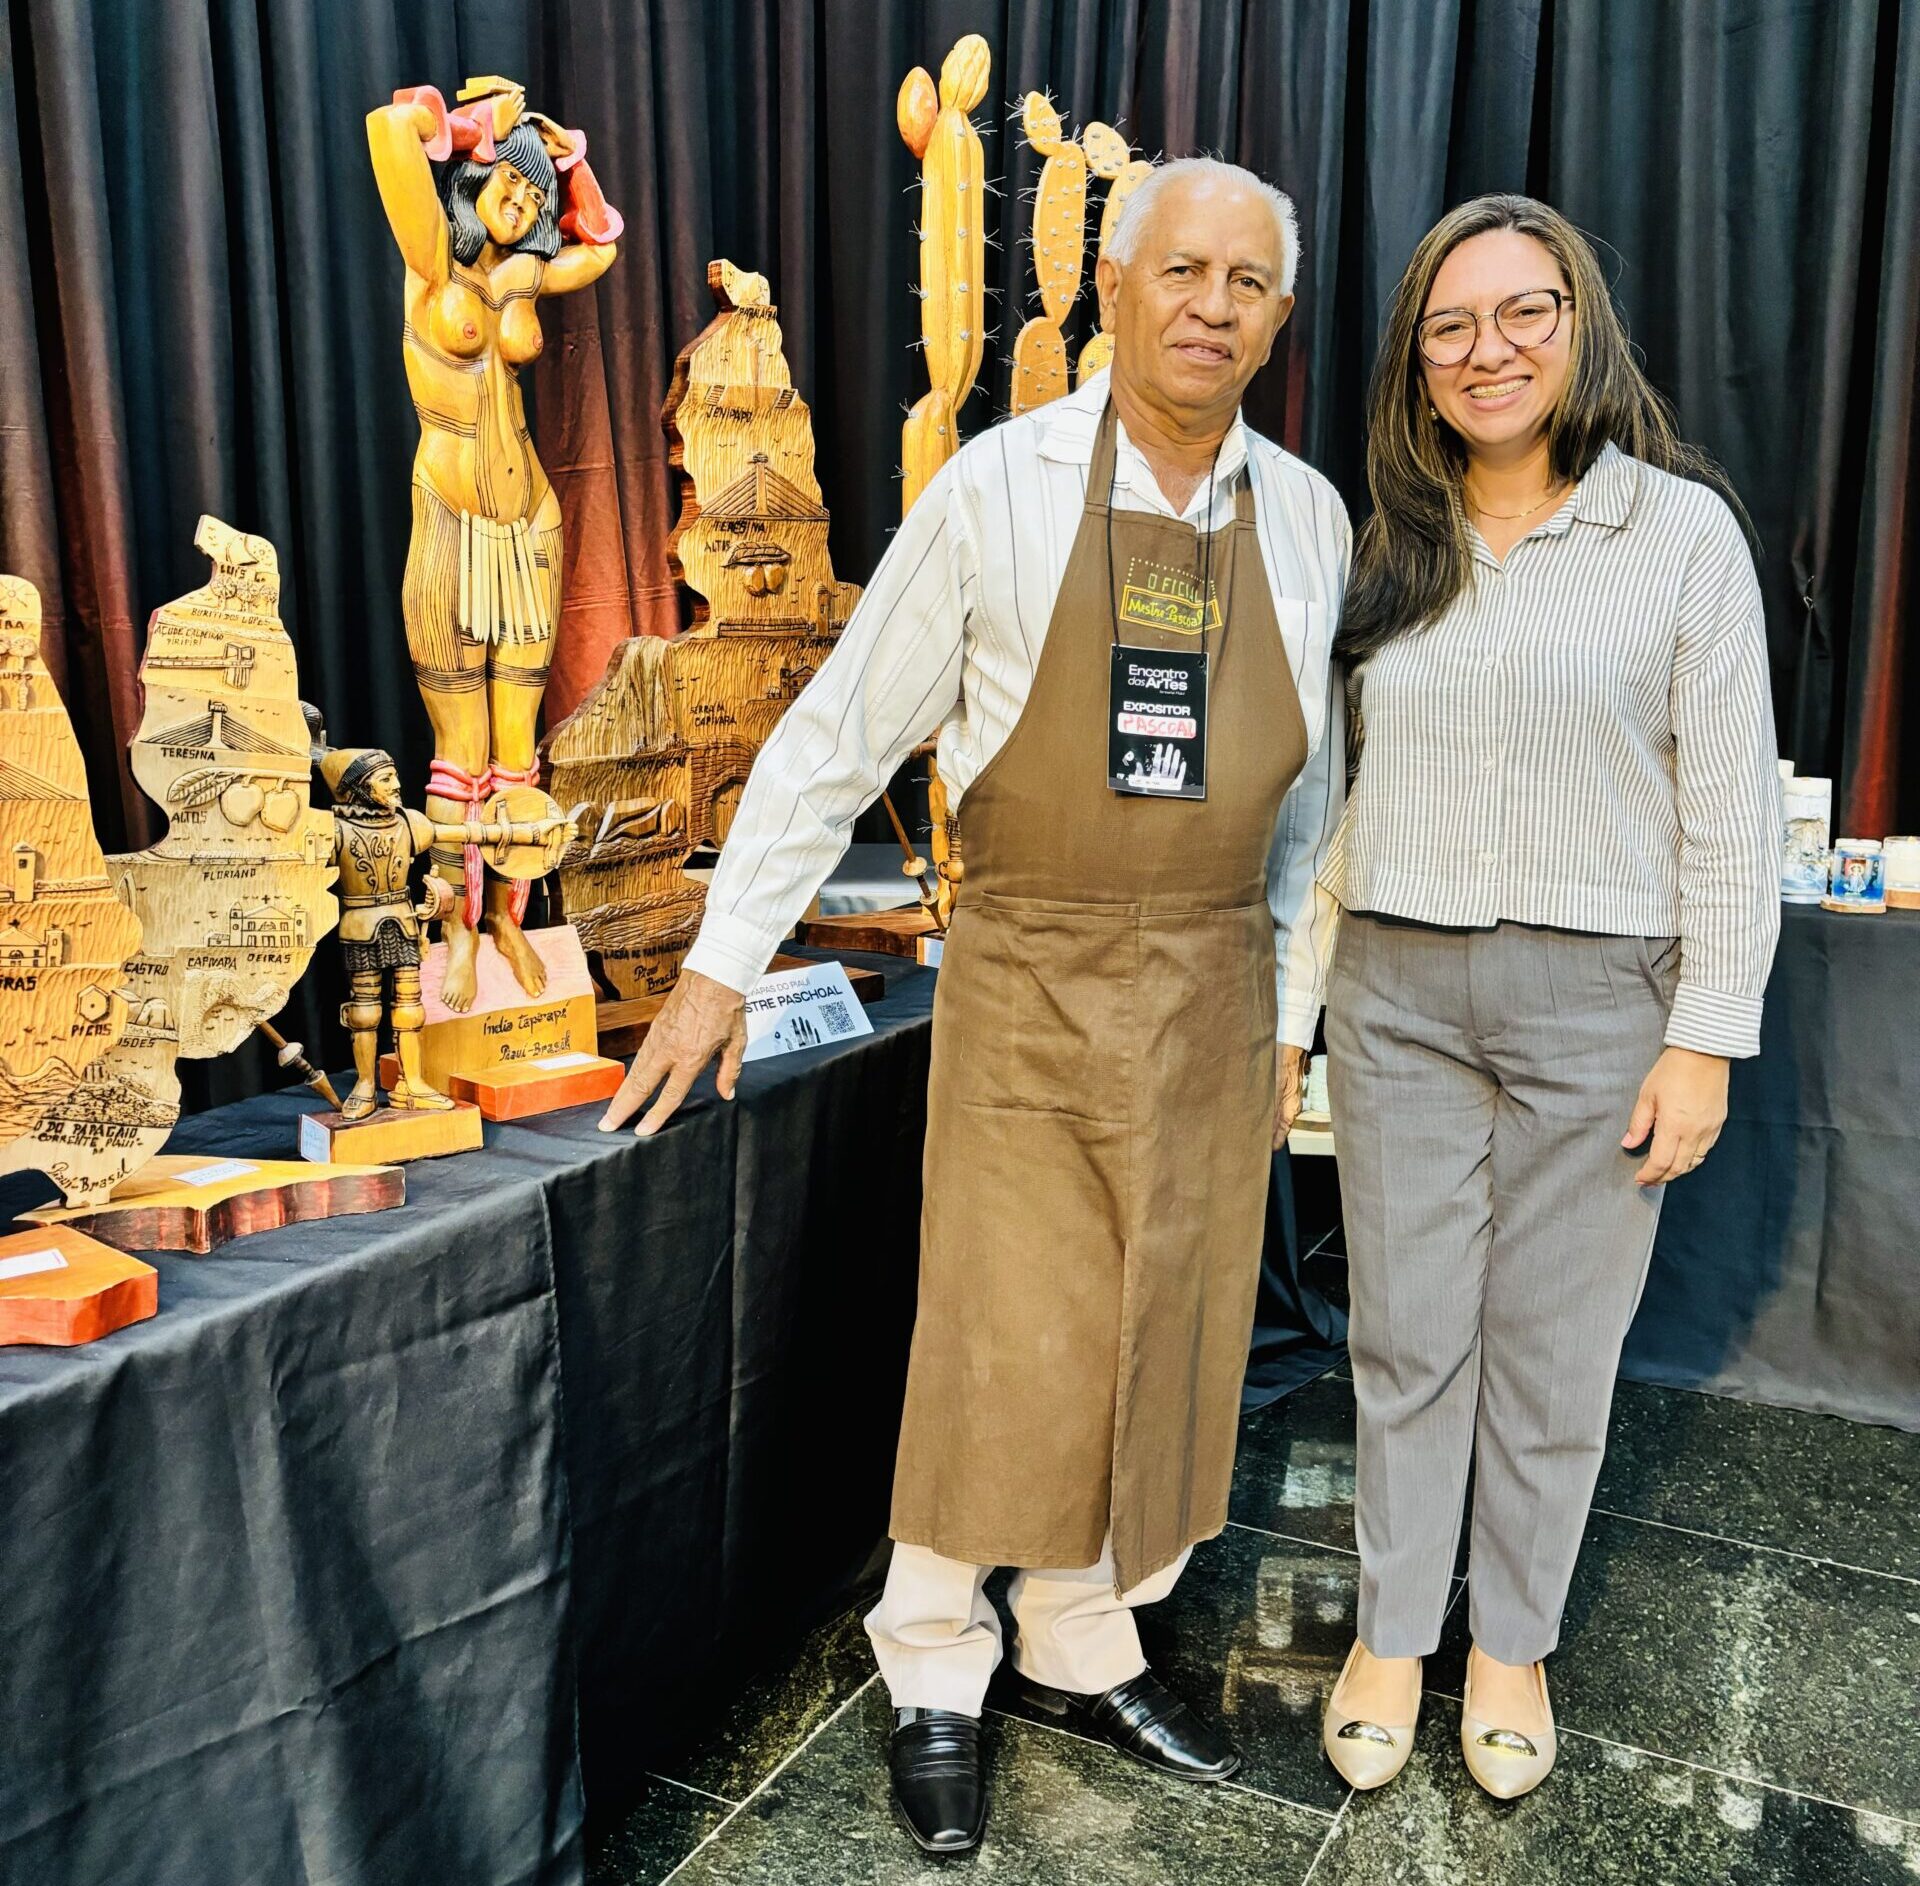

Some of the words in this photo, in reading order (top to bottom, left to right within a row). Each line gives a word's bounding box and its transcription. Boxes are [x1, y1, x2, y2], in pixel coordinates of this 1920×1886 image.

[1128, 664, 1188, 680] Encontro
[1123, 700, 1191, 717] EXPOSITOR
[160, 747, 216, 761] TERESINA
[170, 810, 208, 824] ALTOS
[203, 868, 257, 882] FLORIANO
[247, 953, 292, 964] OEIRAS
[124, 962, 170, 976] CASTRO
[776, 981, 790, 992] DO
[776, 984, 844, 1007] PASCHOAL
[71, 1023, 112, 1037] PICOS
[47, 1121, 65, 1133] DO
[72, 1124, 138, 1139] PAPAGAIO
